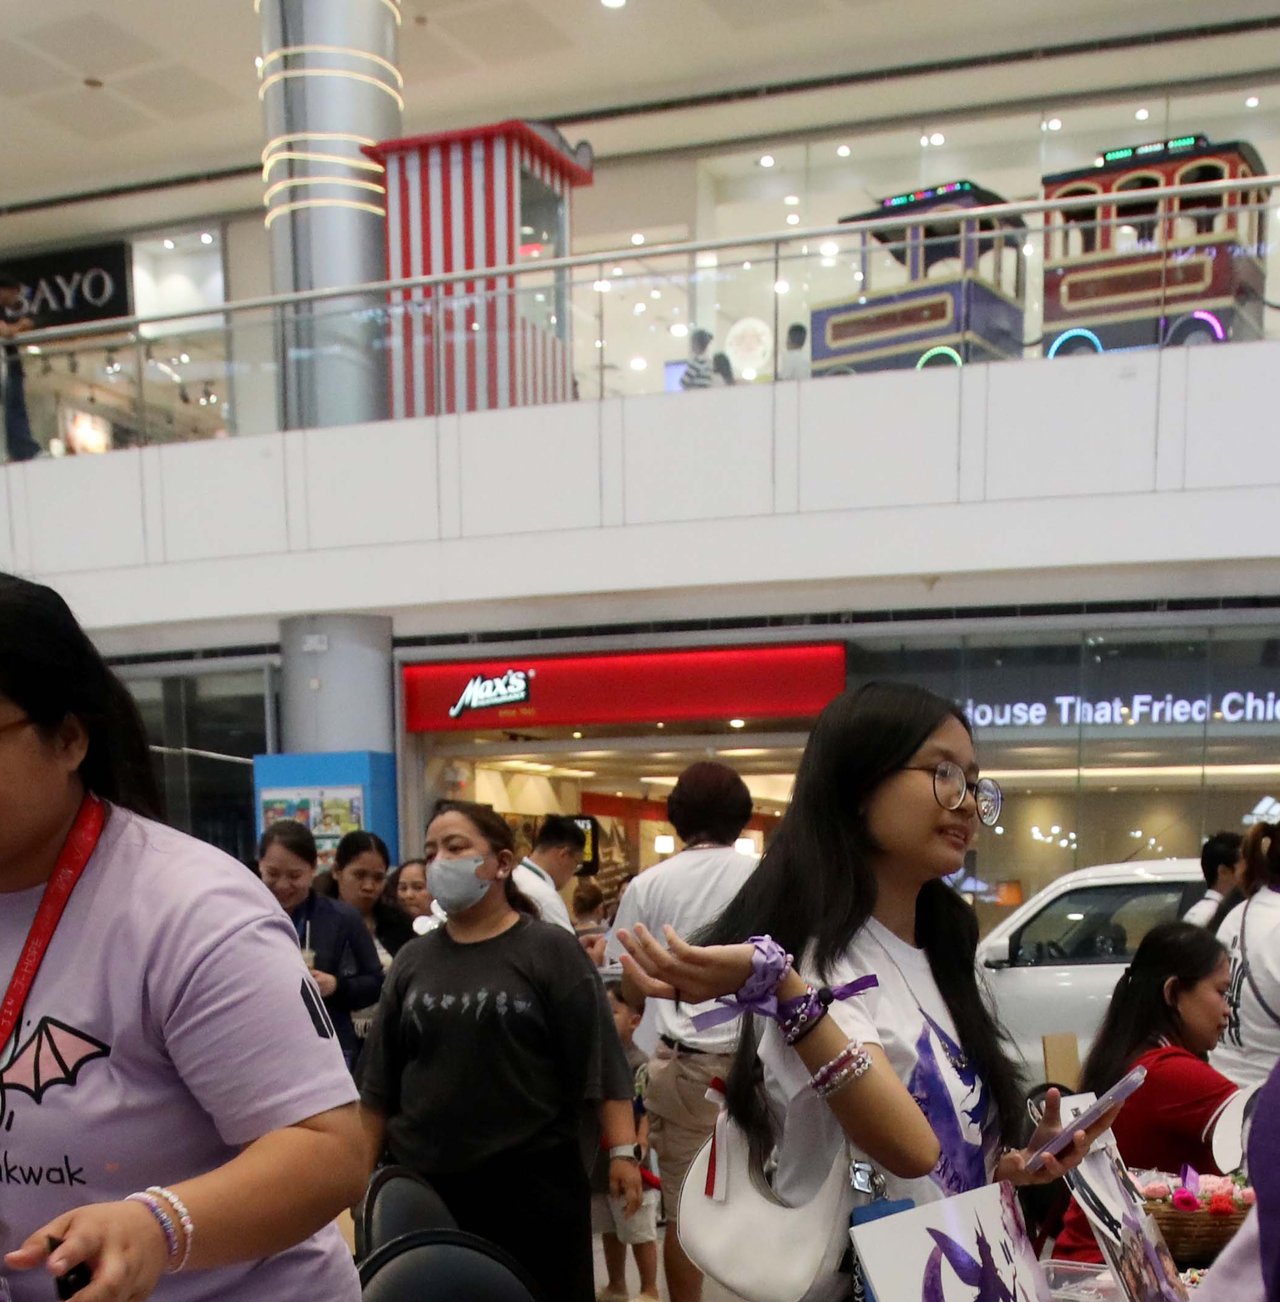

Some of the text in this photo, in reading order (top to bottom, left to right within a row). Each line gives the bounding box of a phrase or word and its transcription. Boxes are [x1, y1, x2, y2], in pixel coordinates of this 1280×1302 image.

[448, 669, 526, 717] Max's
[1055, 695, 1125, 724] That
[1132, 693, 1211, 723] Fried
